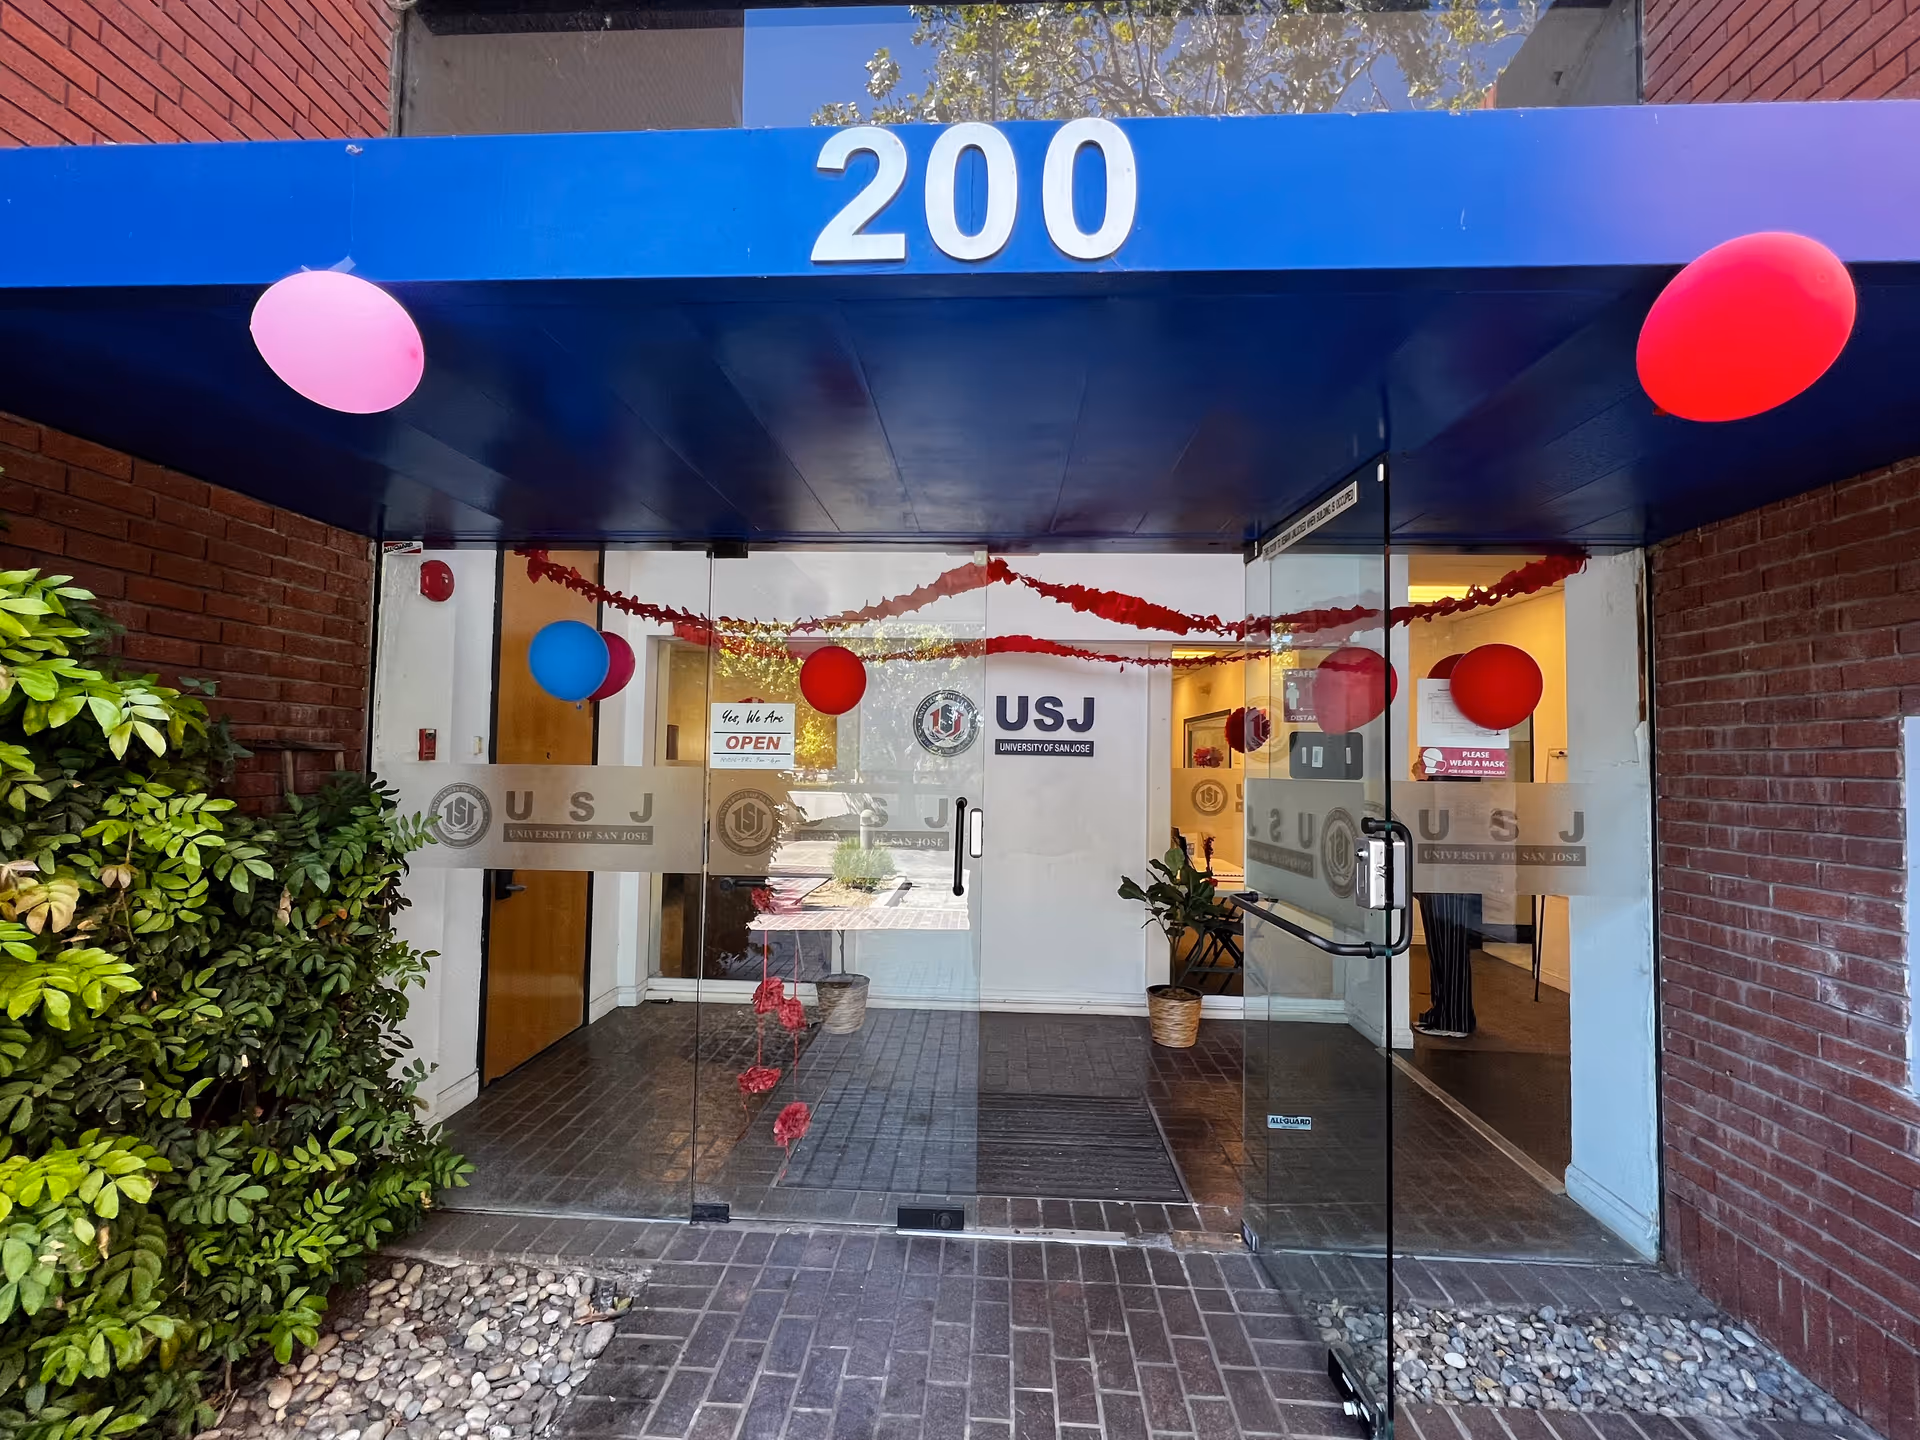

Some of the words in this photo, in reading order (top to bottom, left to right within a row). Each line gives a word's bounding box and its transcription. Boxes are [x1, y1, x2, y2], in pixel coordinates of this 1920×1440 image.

[811, 117, 1137, 263] 200
[722, 710, 740, 725] Yes,
[746, 710, 761, 724] We
[764, 710, 784, 724] Are
[996, 696, 1094, 732] USJ
[726, 736, 781, 750] OPEN
[1000, 743, 1042, 752] UNIVERSITY
[1044, 744, 1053, 752] OF
[1055, 744, 1070, 752] SAN
[1071, 744, 1090, 753] JOSE
[1482, 760, 1504, 768] MASK
[509, 830, 574, 840] UNIVERSITY
[578, 830, 592, 840] OF
[596, 831, 618, 840] SAN
[622, 832, 648, 841] JOSE
[916, 838, 944, 848] JOSE
[1424, 850, 1496, 861] UNIVERSITY
[1522, 852, 1546, 862] SAN
[1552, 852, 1580, 862] JOSE
